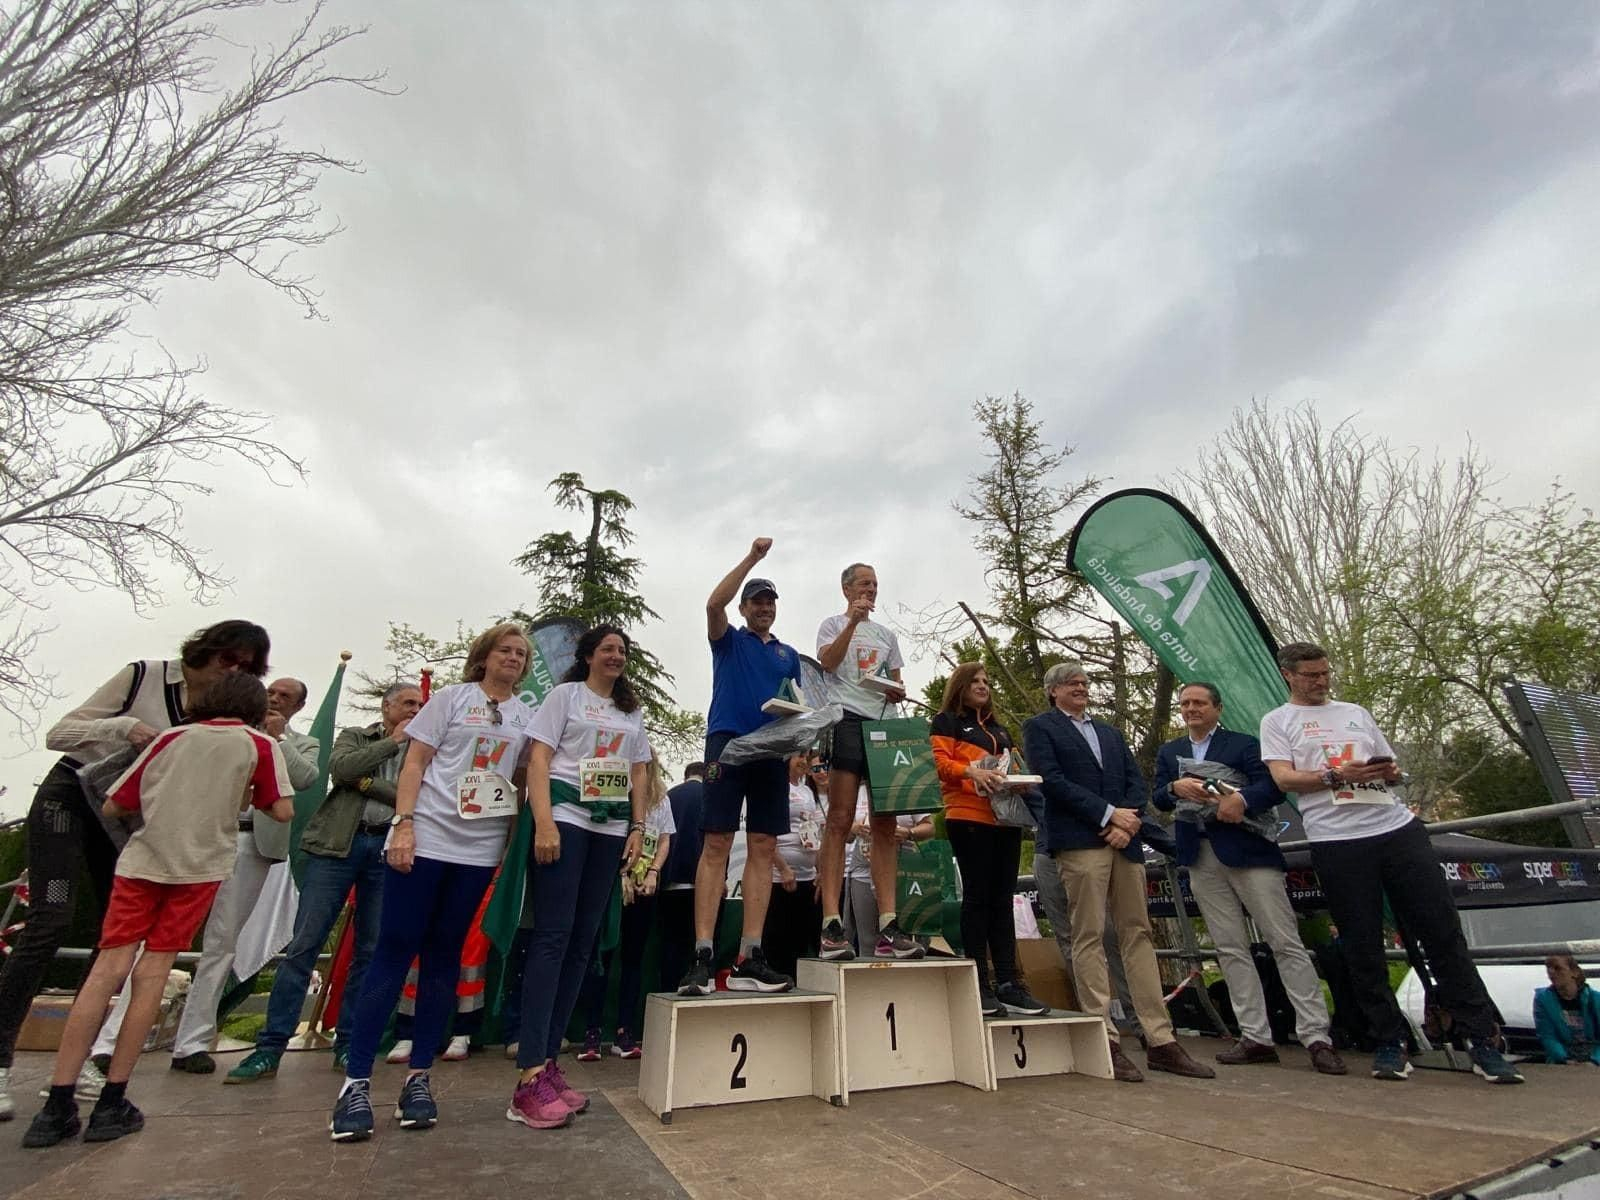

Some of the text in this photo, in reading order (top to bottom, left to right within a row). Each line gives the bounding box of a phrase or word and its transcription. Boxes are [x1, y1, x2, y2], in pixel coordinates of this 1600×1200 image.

[494, 788, 504, 801] 2
[597, 774, 628, 788] 5750
[885, 1002, 898, 1051] 1
[1010, 1024, 1027, 1070] 3
[729, 1032, 749, 1090] 2
